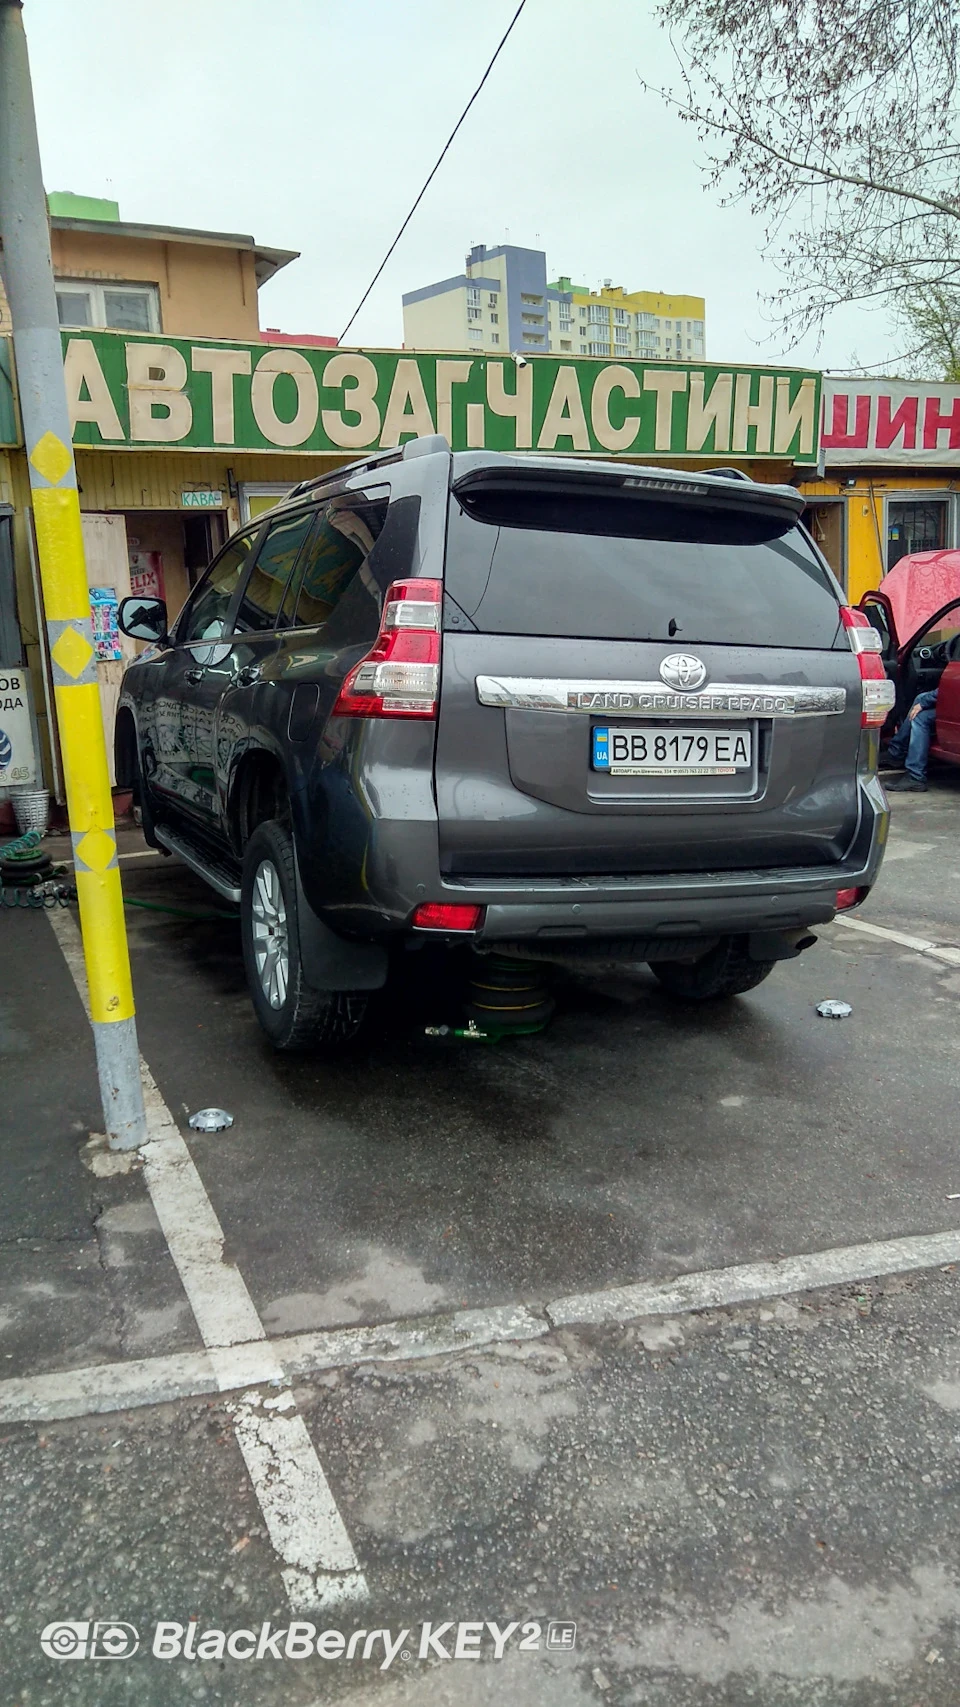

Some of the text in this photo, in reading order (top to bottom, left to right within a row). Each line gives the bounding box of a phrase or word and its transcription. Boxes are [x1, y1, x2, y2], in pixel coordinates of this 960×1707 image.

[820, 394, 960, 449] ШИН
[183, 492, 215, 506] КАВА
[577, 692, 787, 711] LAND CRUISER PRADO
[597, 751, 608, 760] UA
[613, 735, 748, 762] BB 8179 EA
[11, 766, 30, 780] 45
